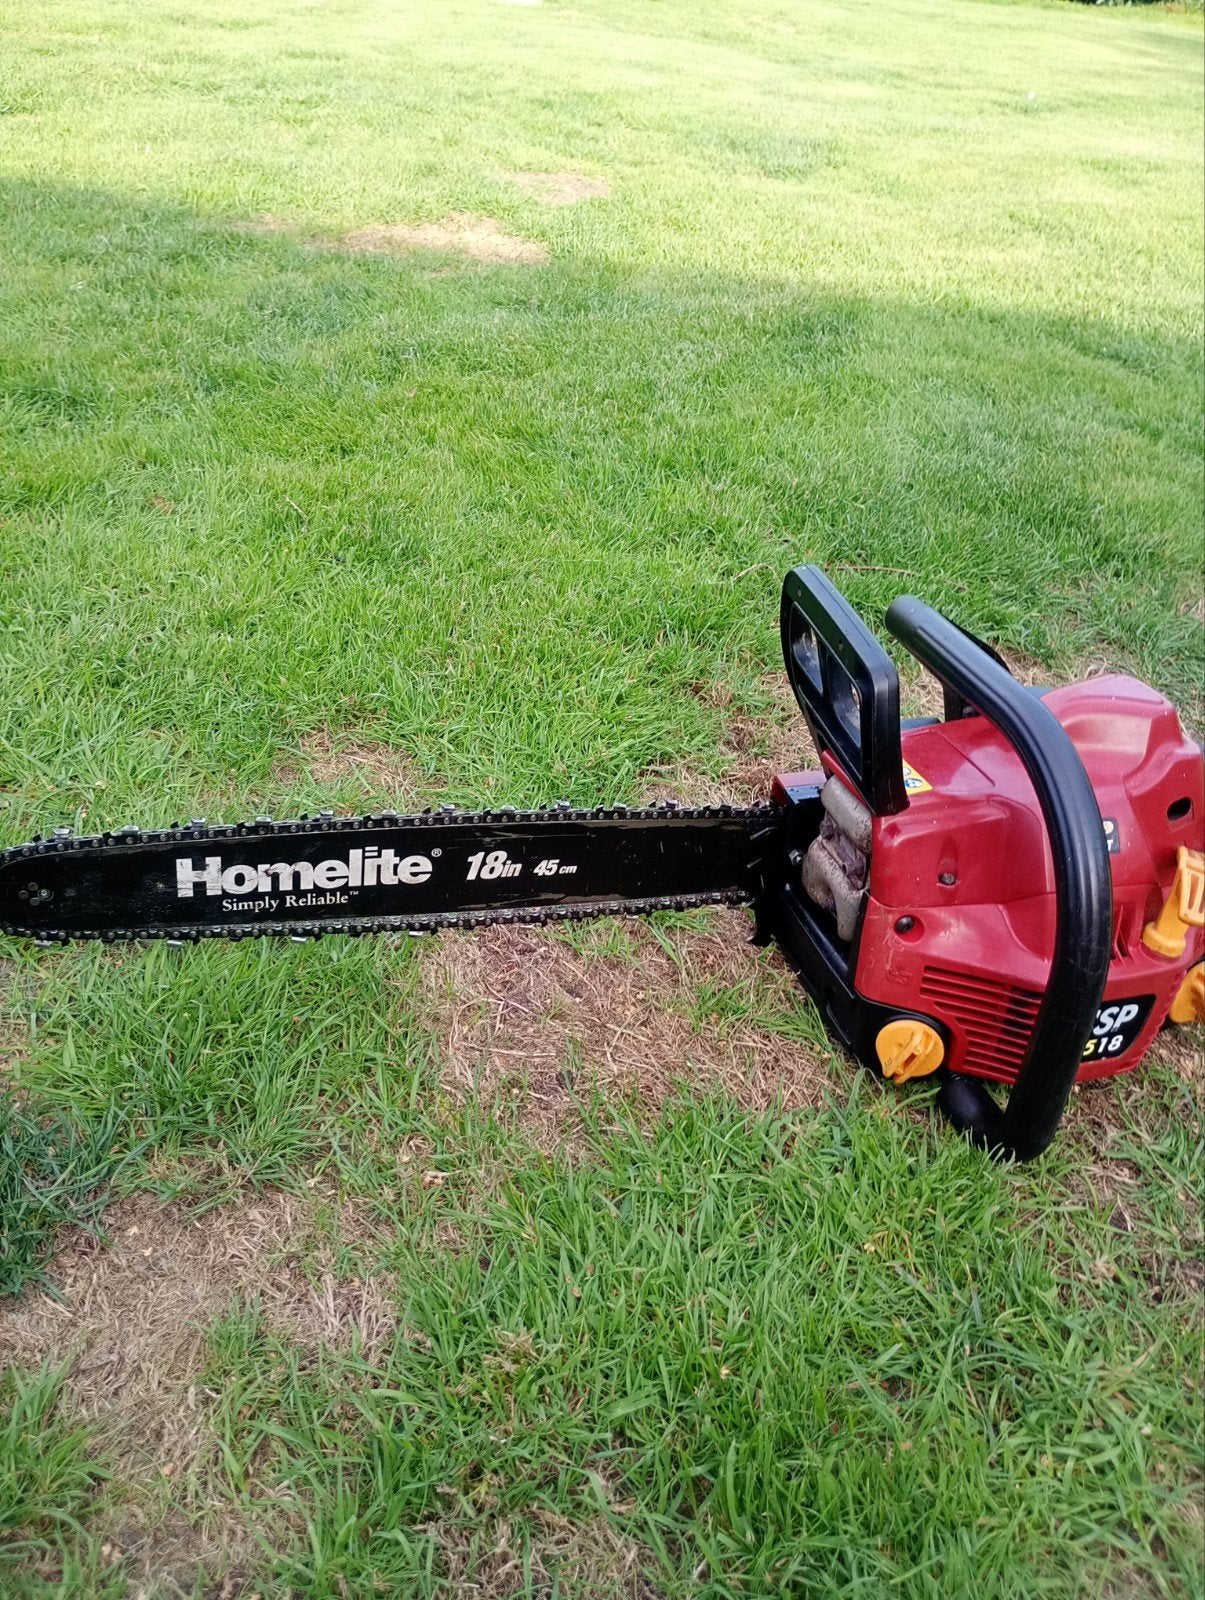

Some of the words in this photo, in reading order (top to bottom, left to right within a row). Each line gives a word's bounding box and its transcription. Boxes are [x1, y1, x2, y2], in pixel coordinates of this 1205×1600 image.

[533, 859, 560, 876] 45
[559, 865, 577, 875] cm
[222, 895, 280, 913] Simply
[1093, 1003, 1139, 1036] SP
